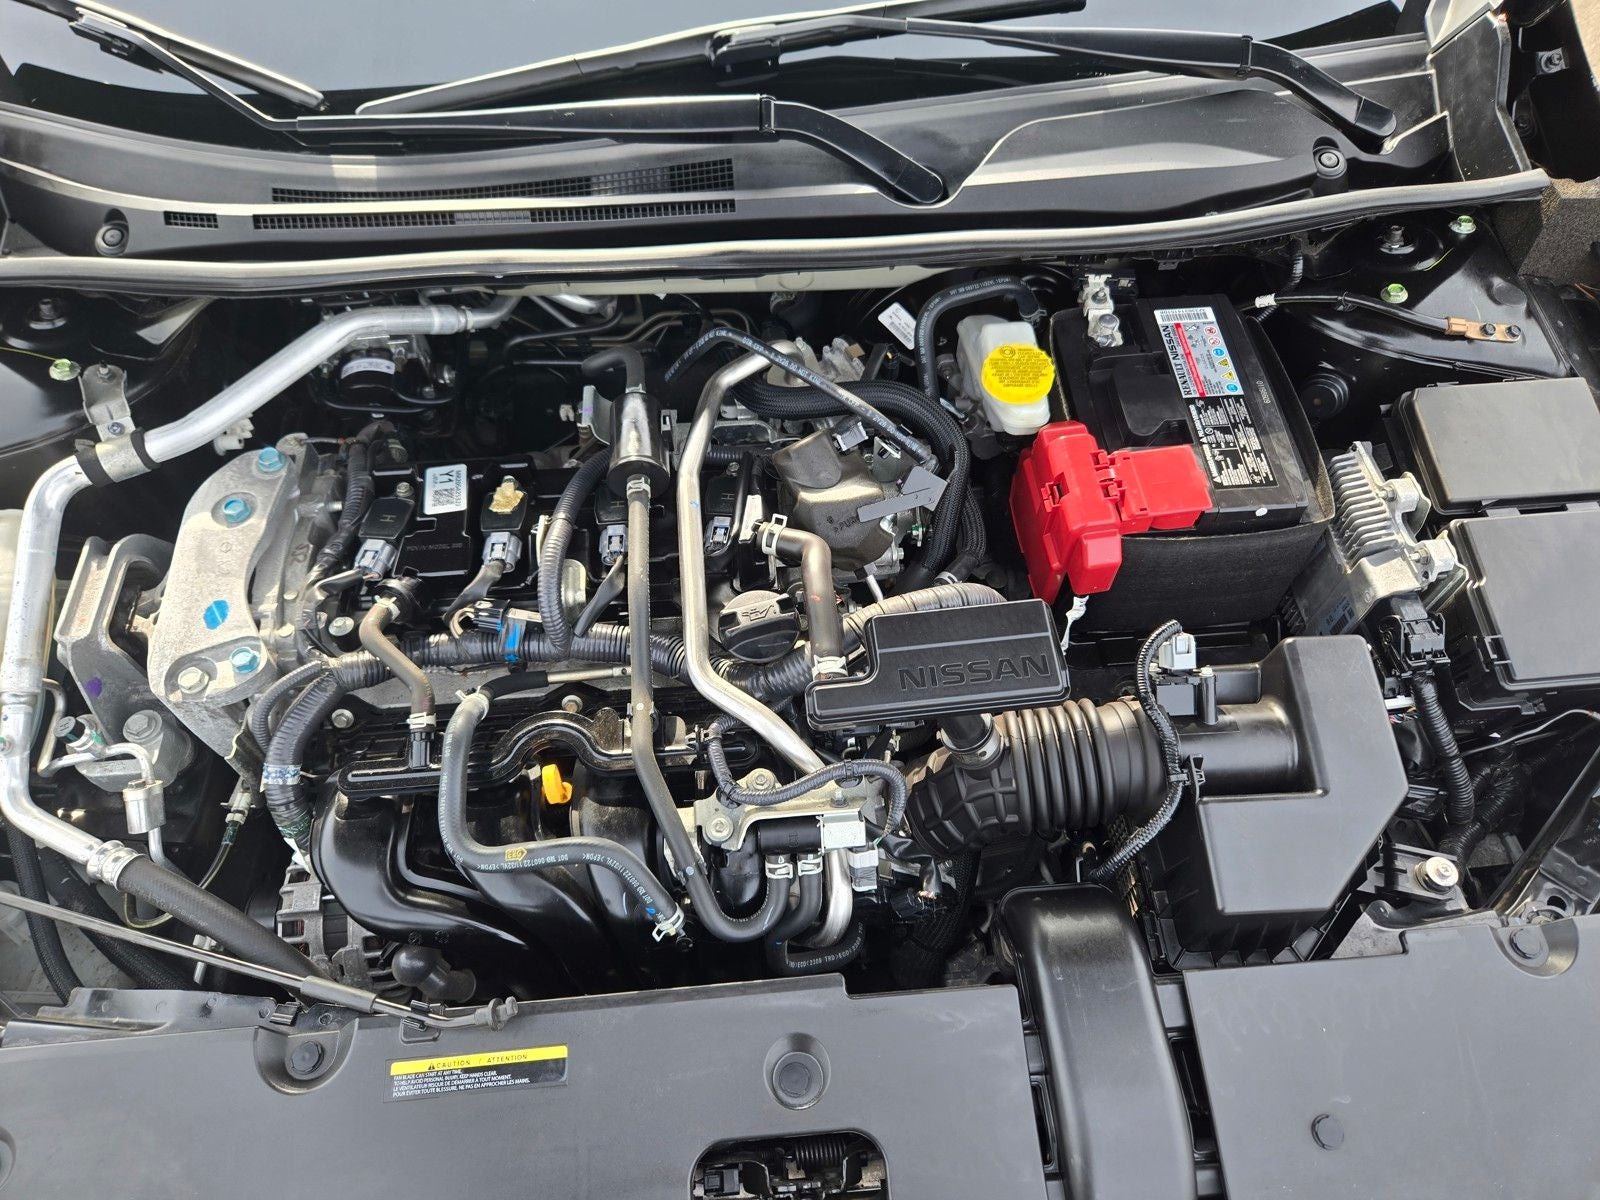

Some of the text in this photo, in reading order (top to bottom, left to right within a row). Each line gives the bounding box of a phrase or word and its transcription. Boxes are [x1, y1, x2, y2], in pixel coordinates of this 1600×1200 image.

[1162, 325, 1193, 396] RENAULT NISSAN
[439, 470, 454, 484] Y1
[898, 654, 1050, 691] NISSAN
[436, 1060, 470, 1068] CAUTION
[487, 1054, 528, 1064] ATTENTION
